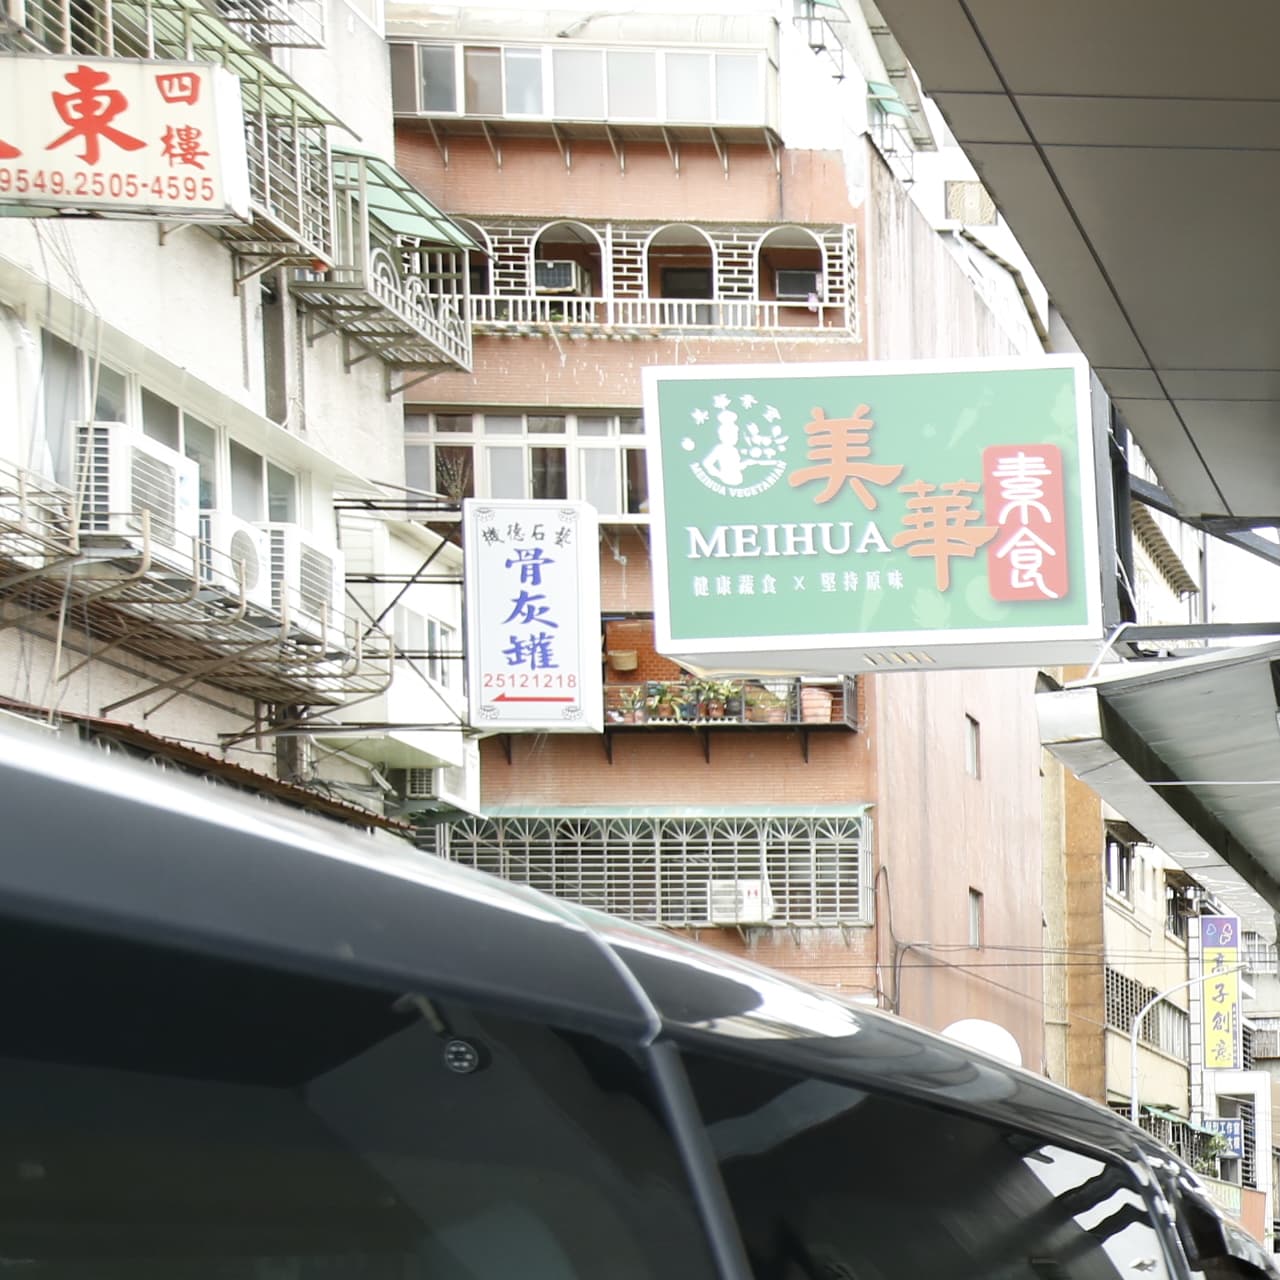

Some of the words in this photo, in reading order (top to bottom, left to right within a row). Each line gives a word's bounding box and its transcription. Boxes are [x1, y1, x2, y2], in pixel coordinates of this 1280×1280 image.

[0, 65, 148, 166] 東
[155, 72, 210, 170] 四樓
[686, 521, 891, 559] MEIHUA
[788, 404, 999, 592] 美華
[991, 452, 1058, 599] 素食
[502, 547, 559, 670] 骨灰罐
[693, 573, 777, 597] 健康蔬食
[820, 569, 904, 592] 堅持原味
[484, 673, 577, 688] 25121218
